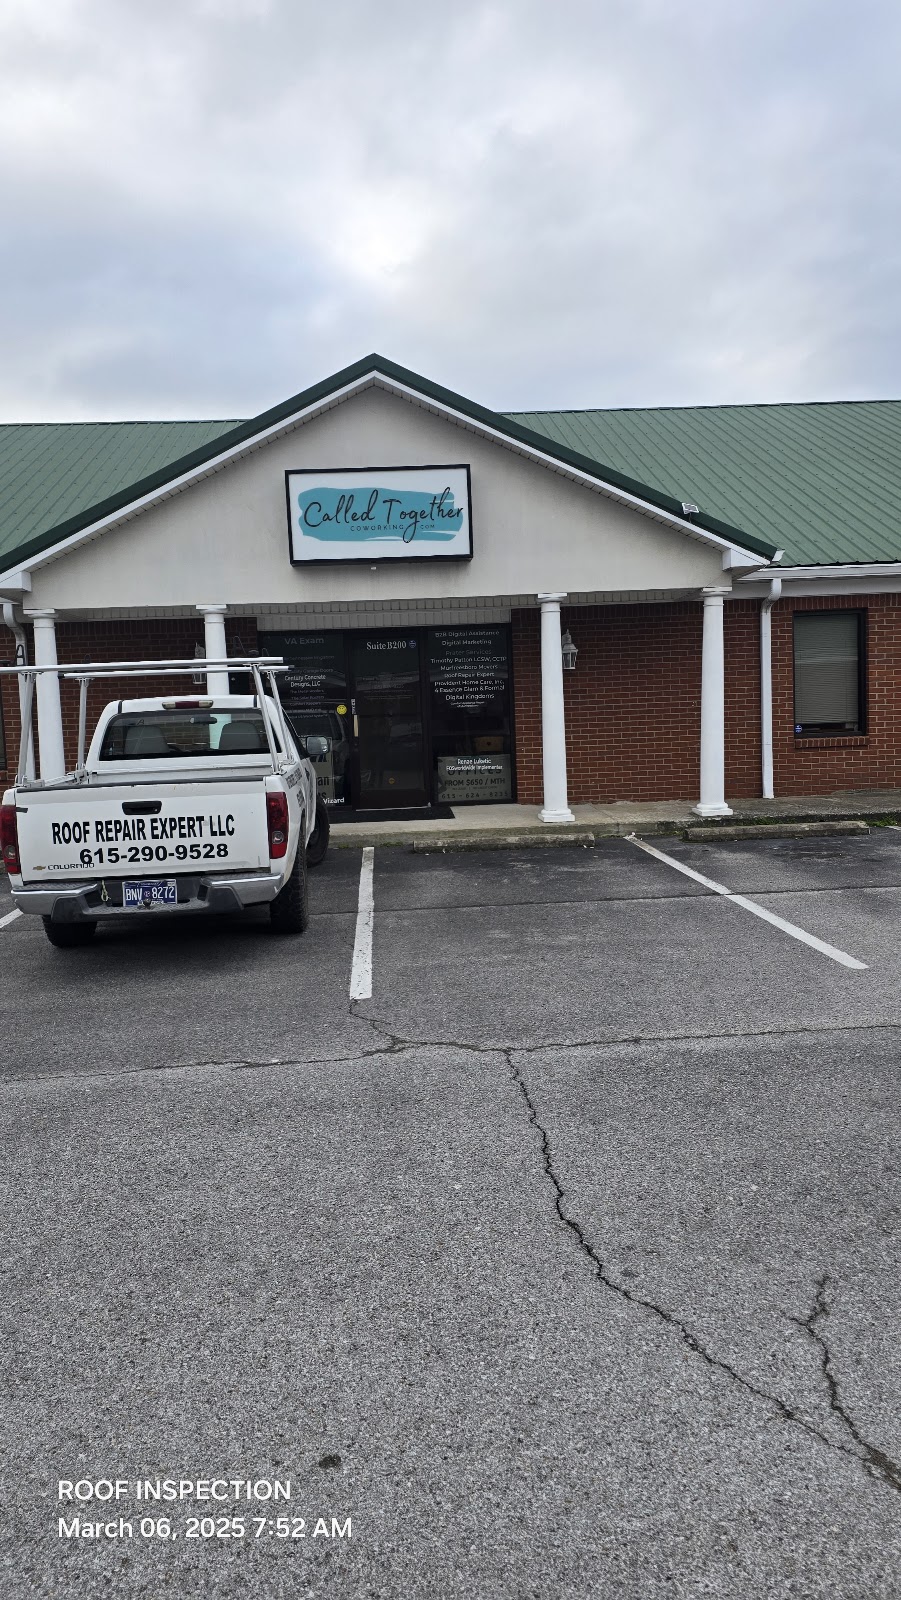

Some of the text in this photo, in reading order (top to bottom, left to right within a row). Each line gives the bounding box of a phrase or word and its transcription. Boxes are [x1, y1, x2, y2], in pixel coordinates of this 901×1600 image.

[304, 486, 463, 543] Called Together
[350, 524, 404, 532] COWORKING
[284, 637, 325, 645] VA Exam
[366, 640, 407, 650] Suite B200
[284, 674, 304, 682] Century
[444, 779, 465, 787] FROM
[466, 778, 484, 787] $650
[490, 777, 506, 785] MTH
[51, 814, 236, 844] ROOF REPAIR EXPERT LLC
[79, 843, 229, 865] 615-290-9528
[47, 862, 95, 871] COLORADO
[125, 886, 175, 901] BNV 8272
